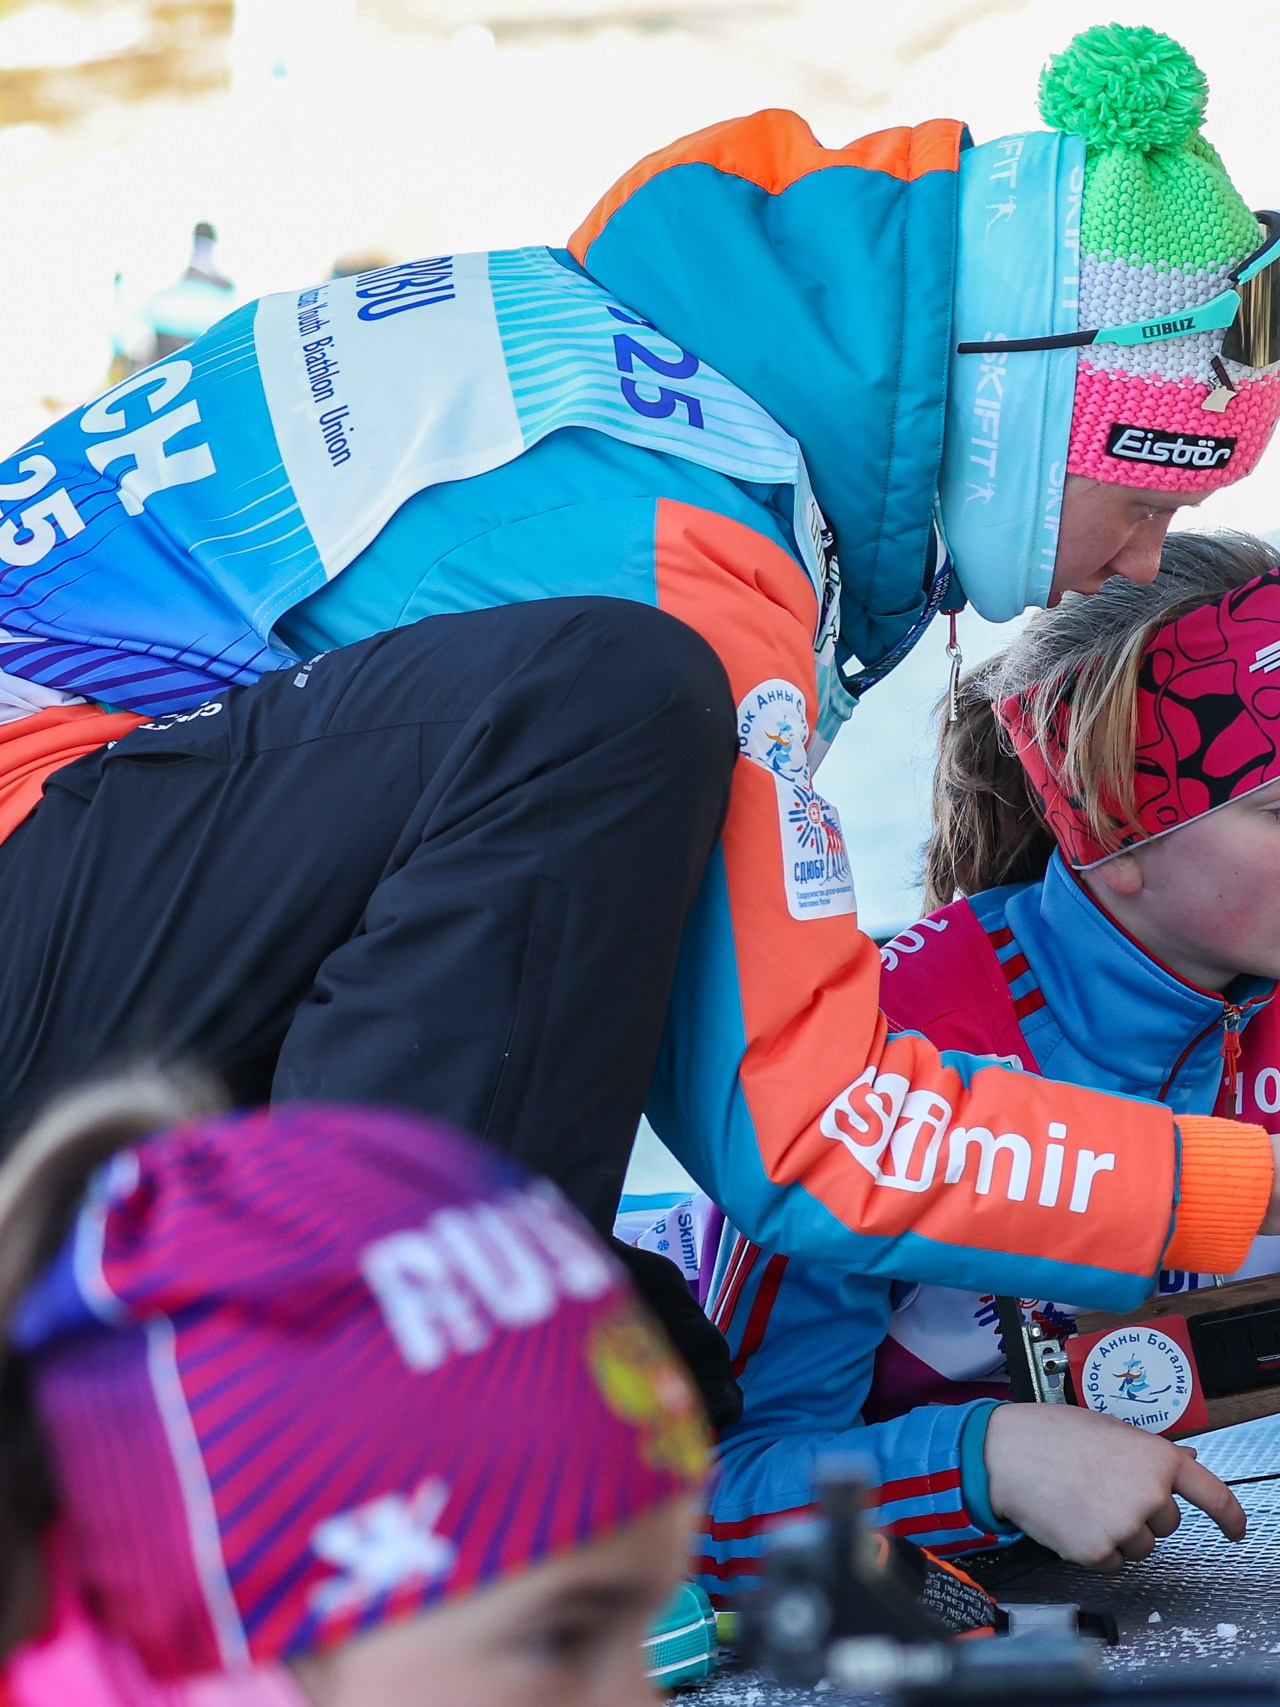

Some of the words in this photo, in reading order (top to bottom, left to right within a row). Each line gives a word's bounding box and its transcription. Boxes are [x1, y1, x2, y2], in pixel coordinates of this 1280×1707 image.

[297, 301, 330, 337] Youth
[1162, 317, 1196, 335] BLIZ
[302, 335, 341, 404] Biathlon
[318, 404, 355, 468] Union
[756, 689, 794, 710] Анны
[794, 858, 825, 885] СДЮБР
[677, 1212, 699, 1272] Skimir
[1086, 1361, 1109, 1413] Кубок
[1098, 1333, 1140, 1359] Анны
[1146, 1332, 1189, 1395] Богалий
[923, 1588, 965, 1611] EasySki
